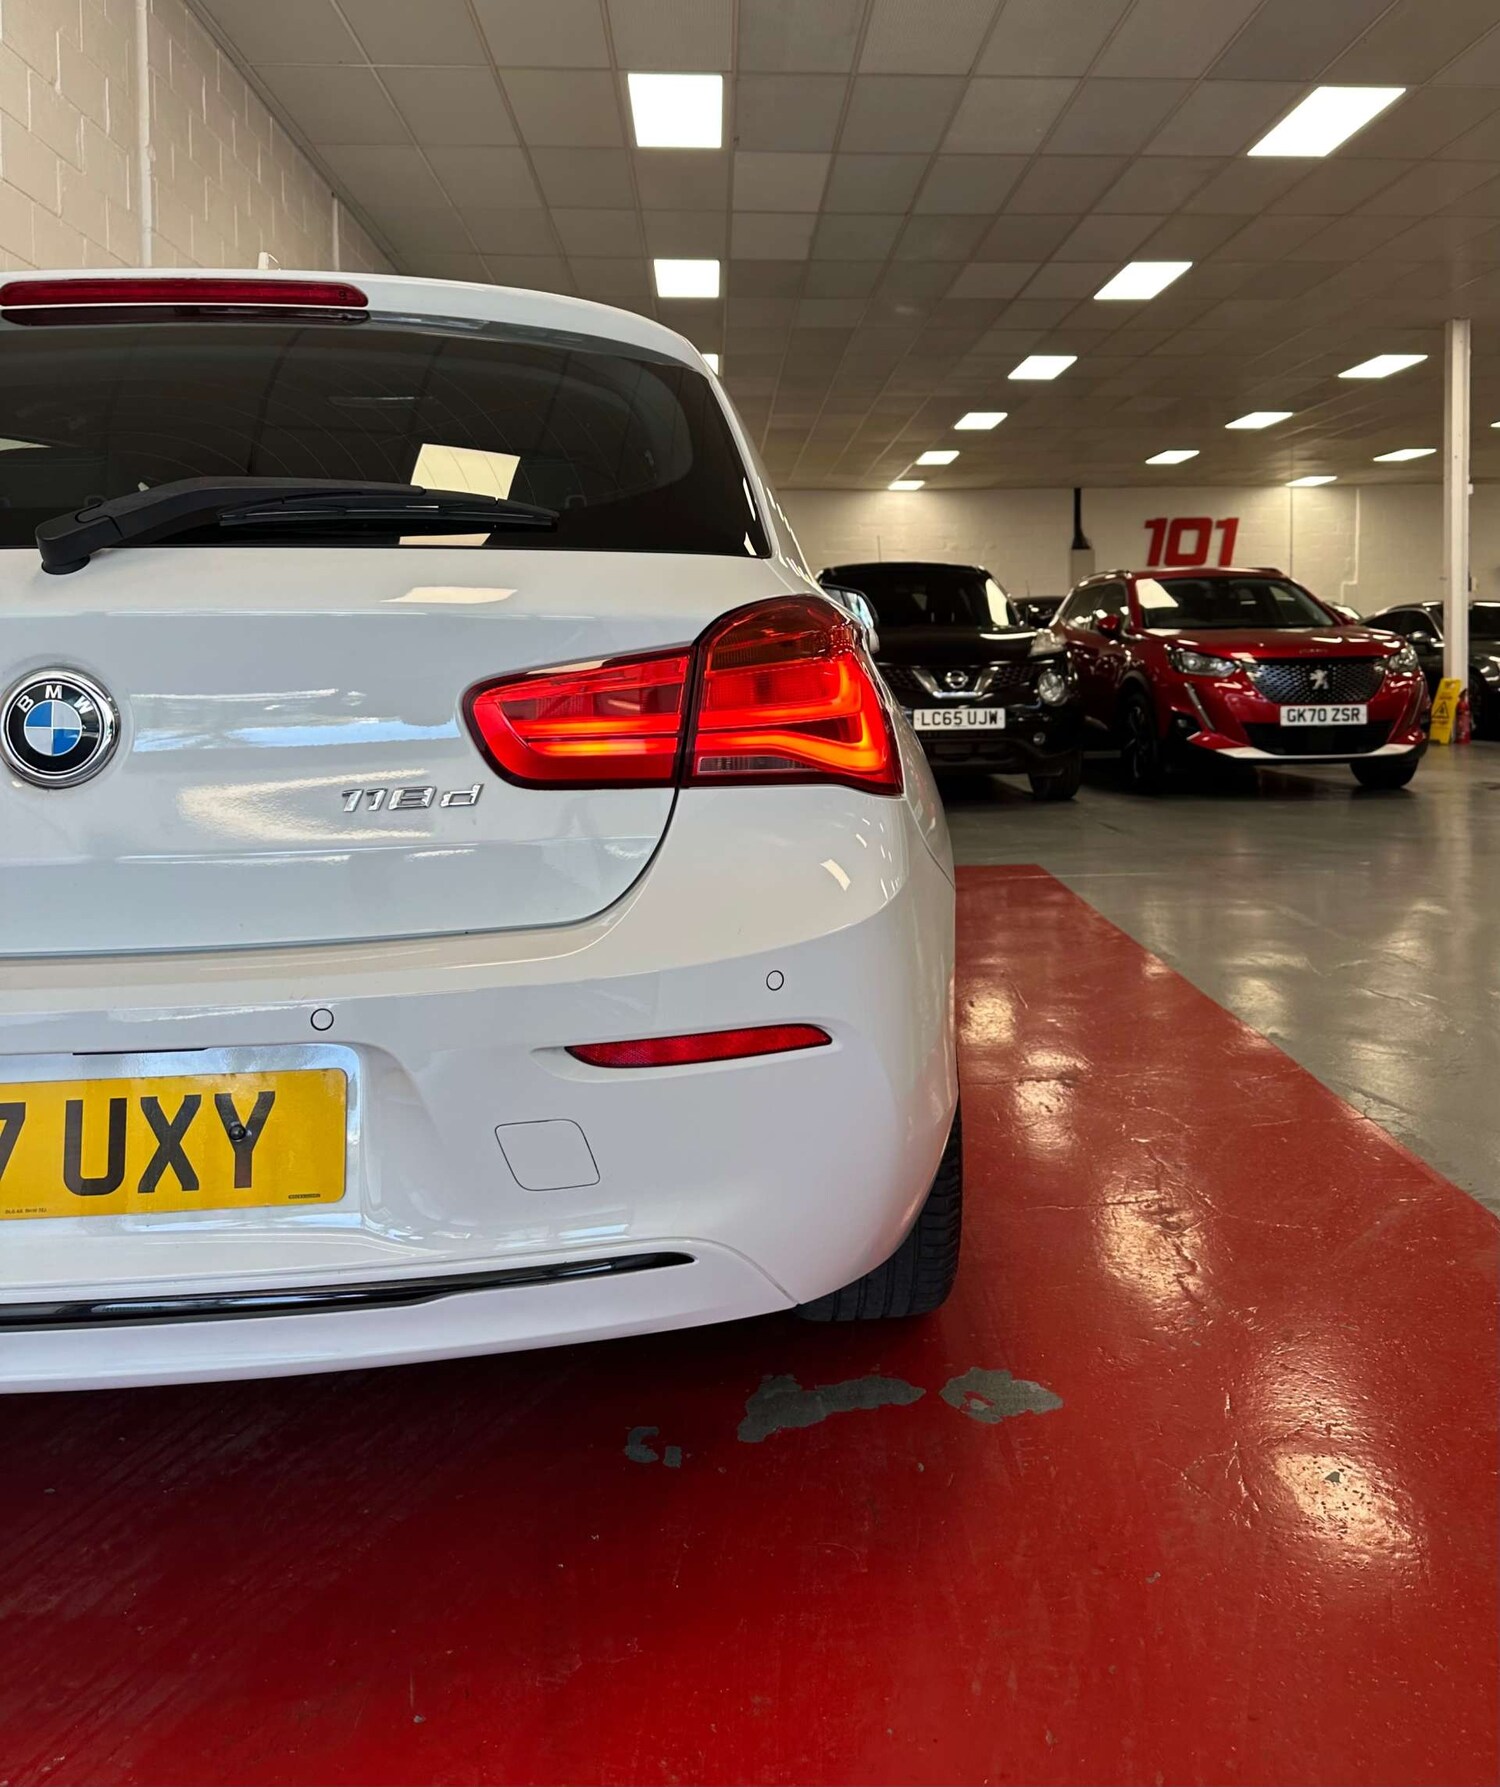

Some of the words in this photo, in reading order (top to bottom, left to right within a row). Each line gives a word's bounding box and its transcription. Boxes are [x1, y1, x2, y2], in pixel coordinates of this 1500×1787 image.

[1144, 517, 1239, 567] 101
[16, 685, 94, 713] BMW
[921, 711, 963, 726] LC65
[967, 711, 998, 725] UJW
[1287, 708, 1327, 722] GK70
[1331, 708, 1360, 721] ZSR
[342, 783, 484, 812] 118d
[63, 1091, 276, 1196] UXY
